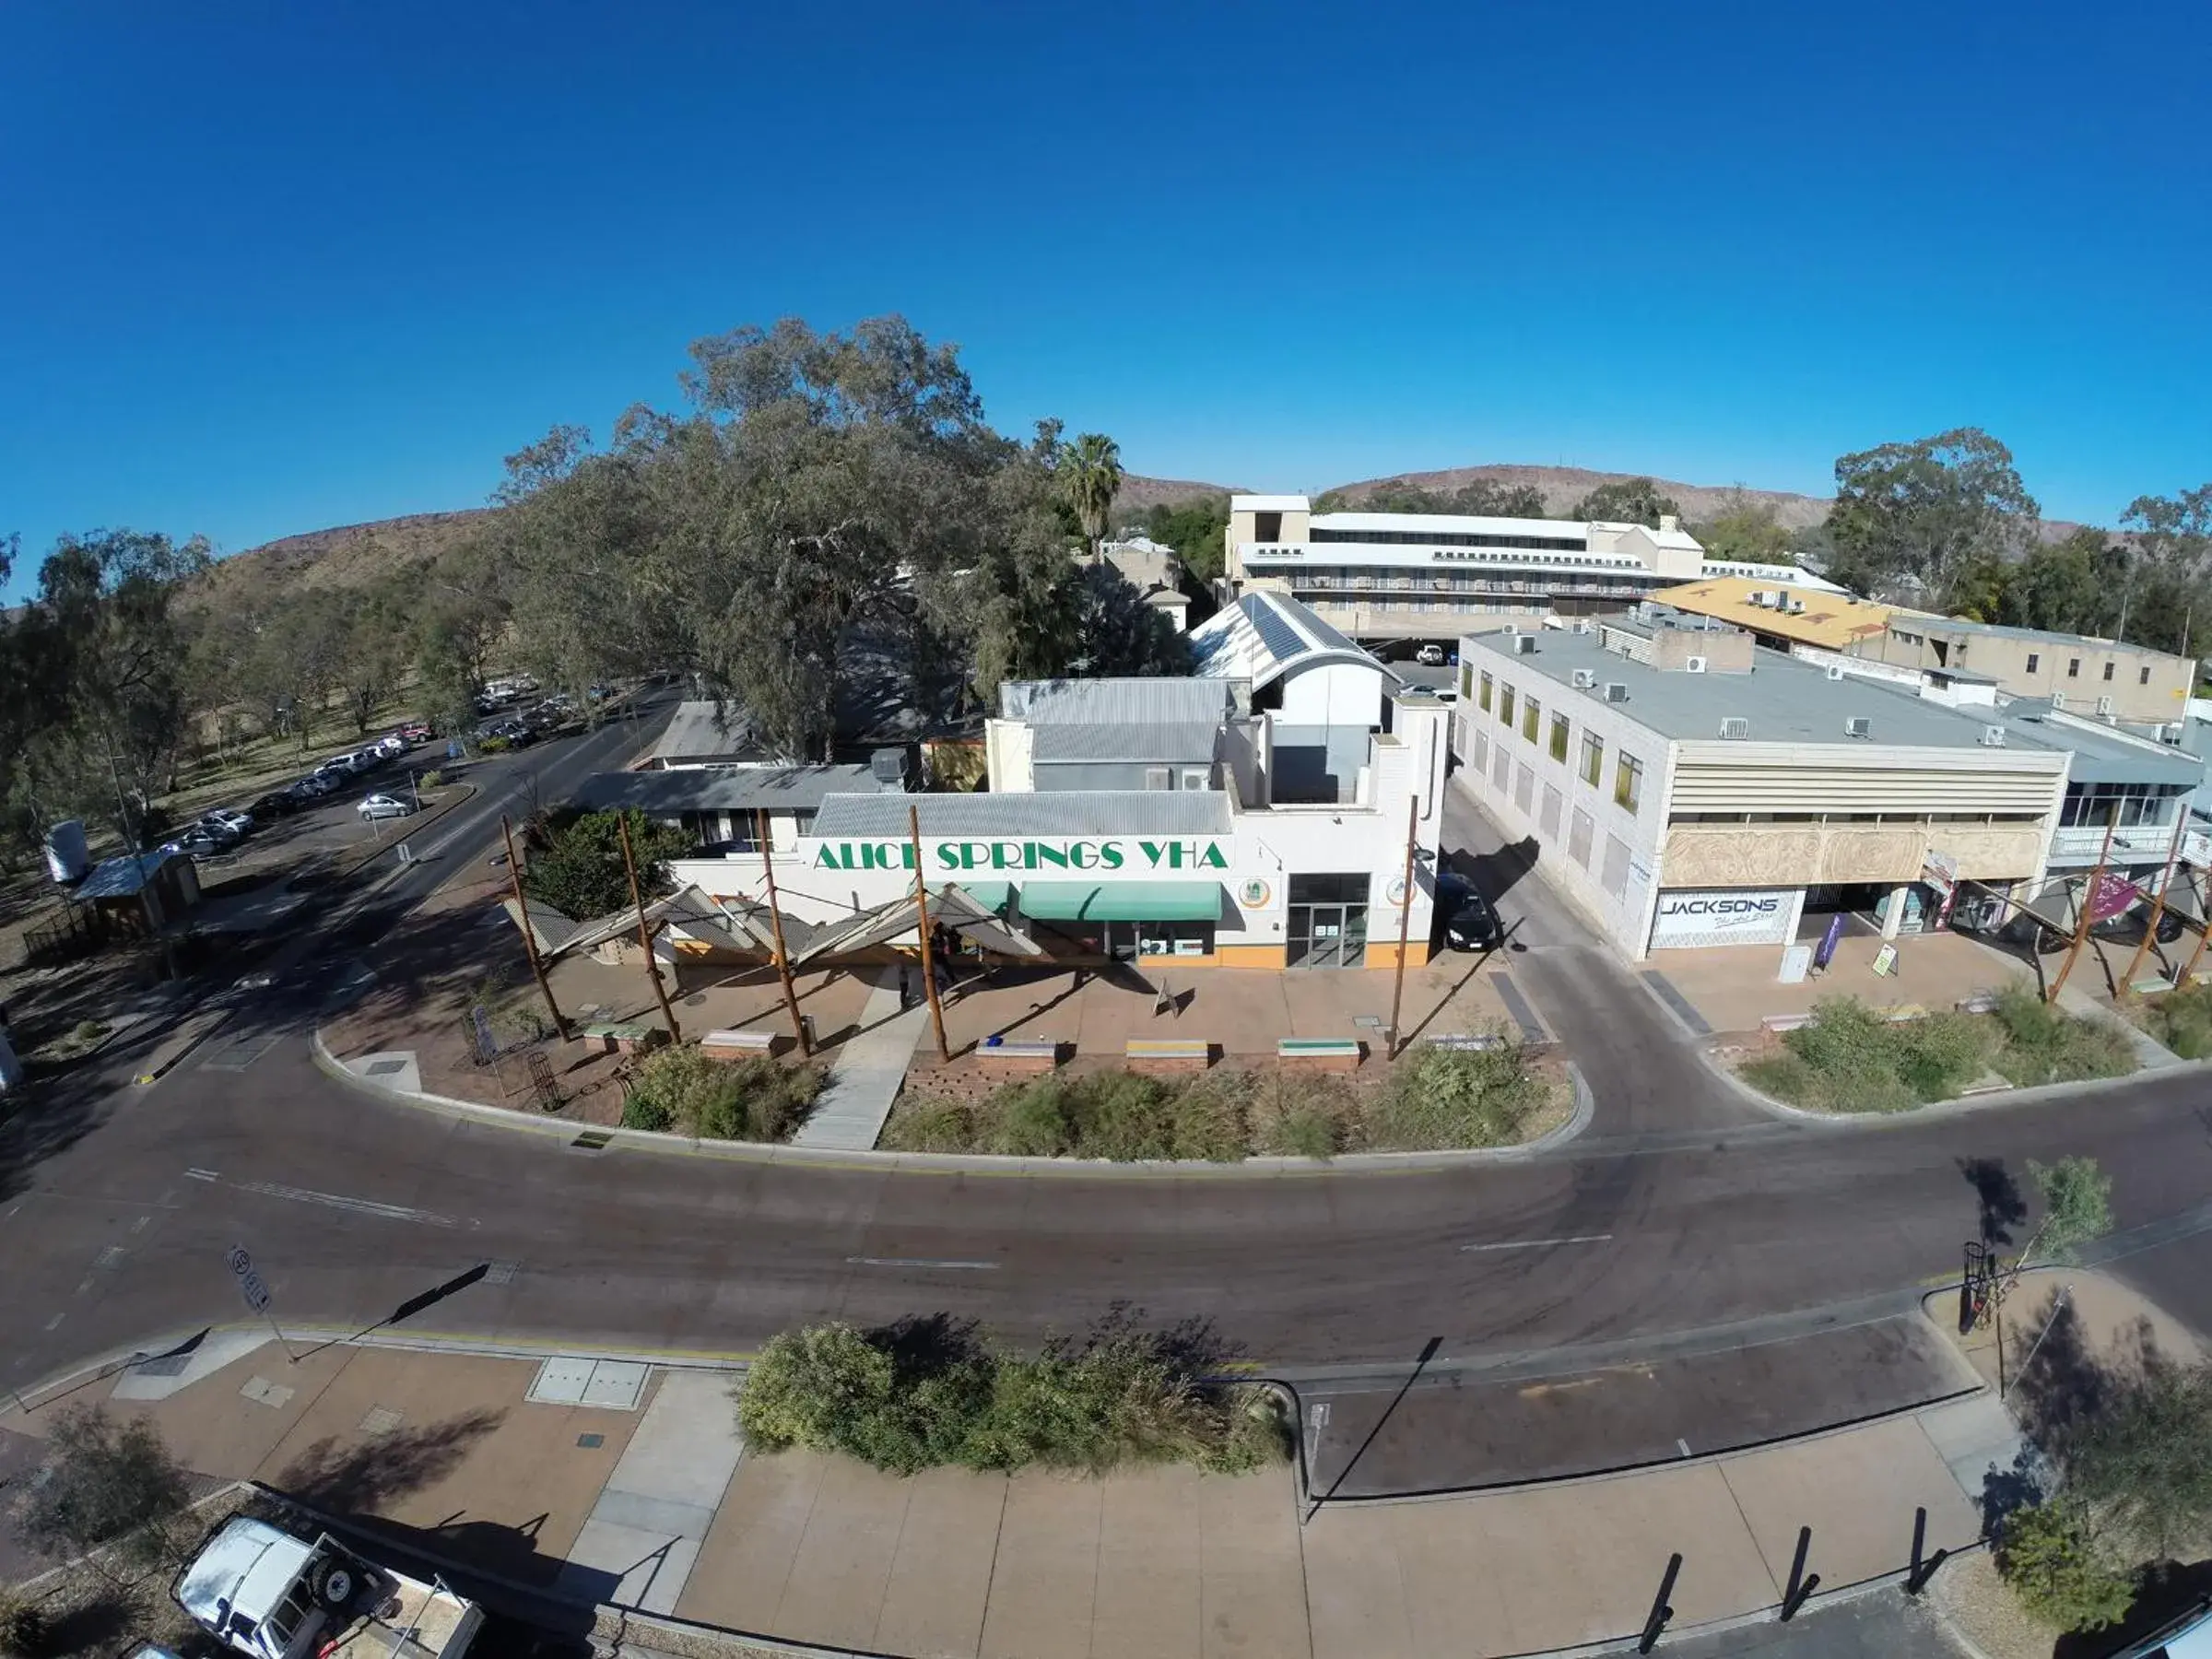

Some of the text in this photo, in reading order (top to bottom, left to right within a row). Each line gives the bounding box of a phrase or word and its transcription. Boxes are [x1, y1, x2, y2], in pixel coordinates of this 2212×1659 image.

[937, 841, 1124, 869] SPRINGS
[1138, 841, 1229, 869] YHA
[1660, 899, 1779, 915] JACKSONS
